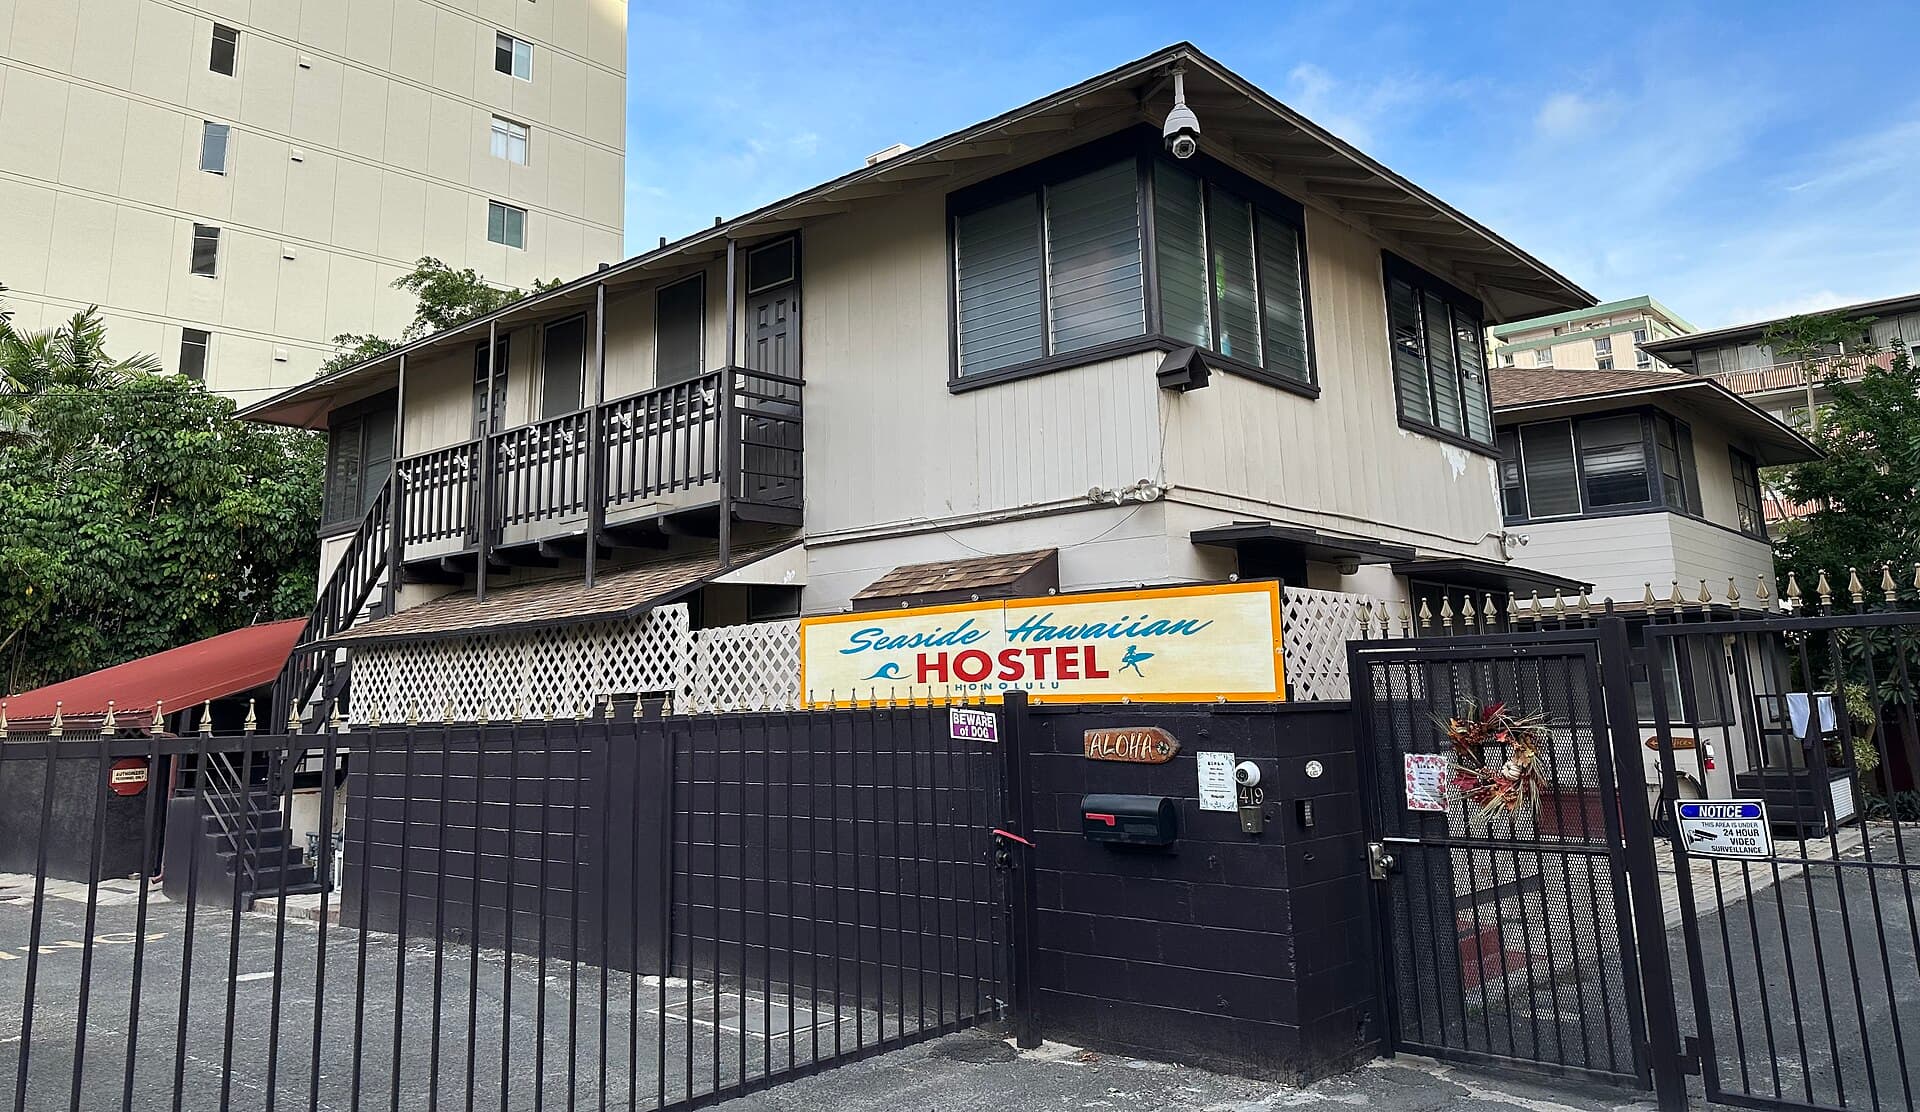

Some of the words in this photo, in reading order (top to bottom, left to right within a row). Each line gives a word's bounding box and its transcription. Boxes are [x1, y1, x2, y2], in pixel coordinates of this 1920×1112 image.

[840, 618, 991, 655] Seaside
[1005, 612, 1214, 643] Hawaiian
[917, 645, 1110, 684] HOSTEL
[955, 682, 1060, 691] HONOLULU
[953, 712, 994, 728] BEWARE
[960, 726, 969, 737] of
[971, 726, 989, 739] DOG
[1089, 732, 1156, 760] ALOHA
[1240, 787, 1263, 805] 419
[1699, 805, 1743, 818] NOTICE
[1723, 828, 1733, 837] 24
[1736, 828, 1760, 837] HOUR
[1730, 837, 1756, 846] VIDEO
[1711, 845, 1762, 854] SURVEILLANCE
